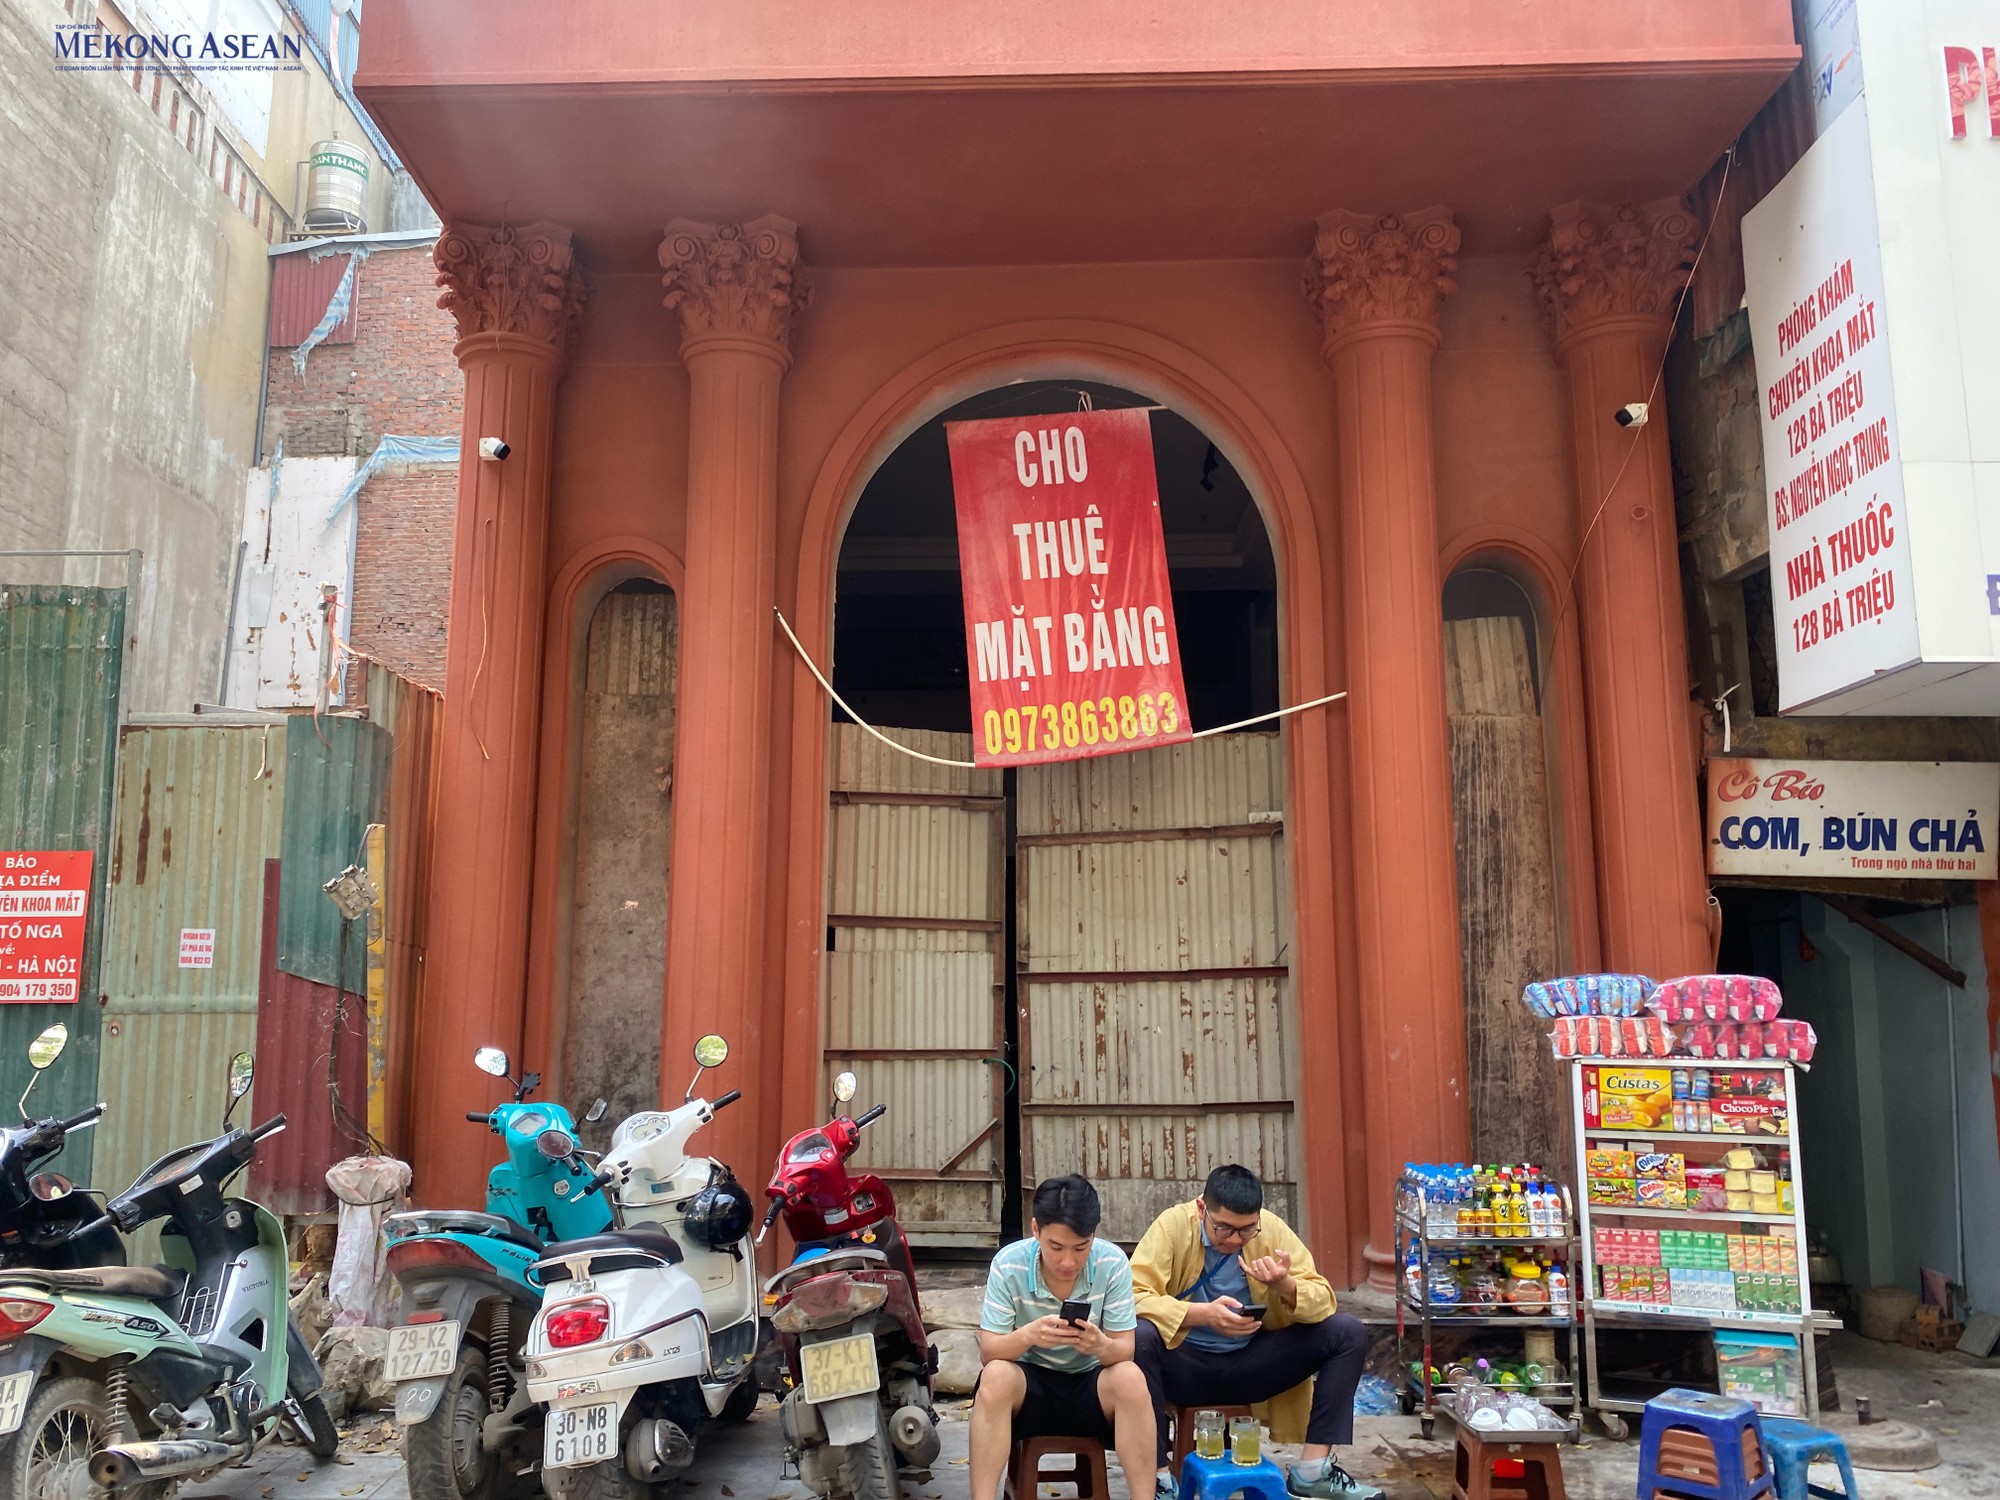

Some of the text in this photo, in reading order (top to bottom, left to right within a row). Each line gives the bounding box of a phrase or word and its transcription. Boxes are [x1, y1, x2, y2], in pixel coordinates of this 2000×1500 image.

[1778, 258, 1854, 357] PHÒNG KHÁM
[1768, 294, 1876, 421] CHUYÊN KHOA MẮT
[1787, 370, 1864, 458] 128 BÀ TRIỆU
[1014, 426, 1088, 487] CHO
[1775, 487, 1790, 531] BS:
[1826, 440, 1854, 497] NGỌC
[1853, 416, 1890, 479] TRUNG
[1012, 504, 1109, 580] THUÊ
[1787, 493, 1895, 601] NHÀ THUỐC
[1793, 568, 1895, 653] 128 BÀ TRIỆU
[974, 584, 1171, 691] MẶT BẰNG
[983, 691, 1179, 755] 0973863863
[1717, 770, 1825, 802] Cô Béo
[1719, 808, 1985, 857] CƠM, BÚN CHẢ
[5, 854, 37, 869] BÁO
[1851, 856, 1976, 871] Trong ngõ nhà thứ hai
[20, 870, 61, 887] ĐIỂM
[21, 897, 52, 912] KHOA
[55, 891, 80, 912] MẮT
[0, 920, 63, 939] TỐ NGA
[18, 955, 39, 974] HÀ
[44, 955, 77, 977] NỘI
[0, 983, 72, 997] 904 179 350
[1606, 1075, 1660, 1090] Custas
[398, 1326, 447, 1353] 29-K2
[391, 1349, 451, 1378] 127.79
[556, 1406, 607, 1436] 30-N8
[555, 1432, 607, 1462] 6108
